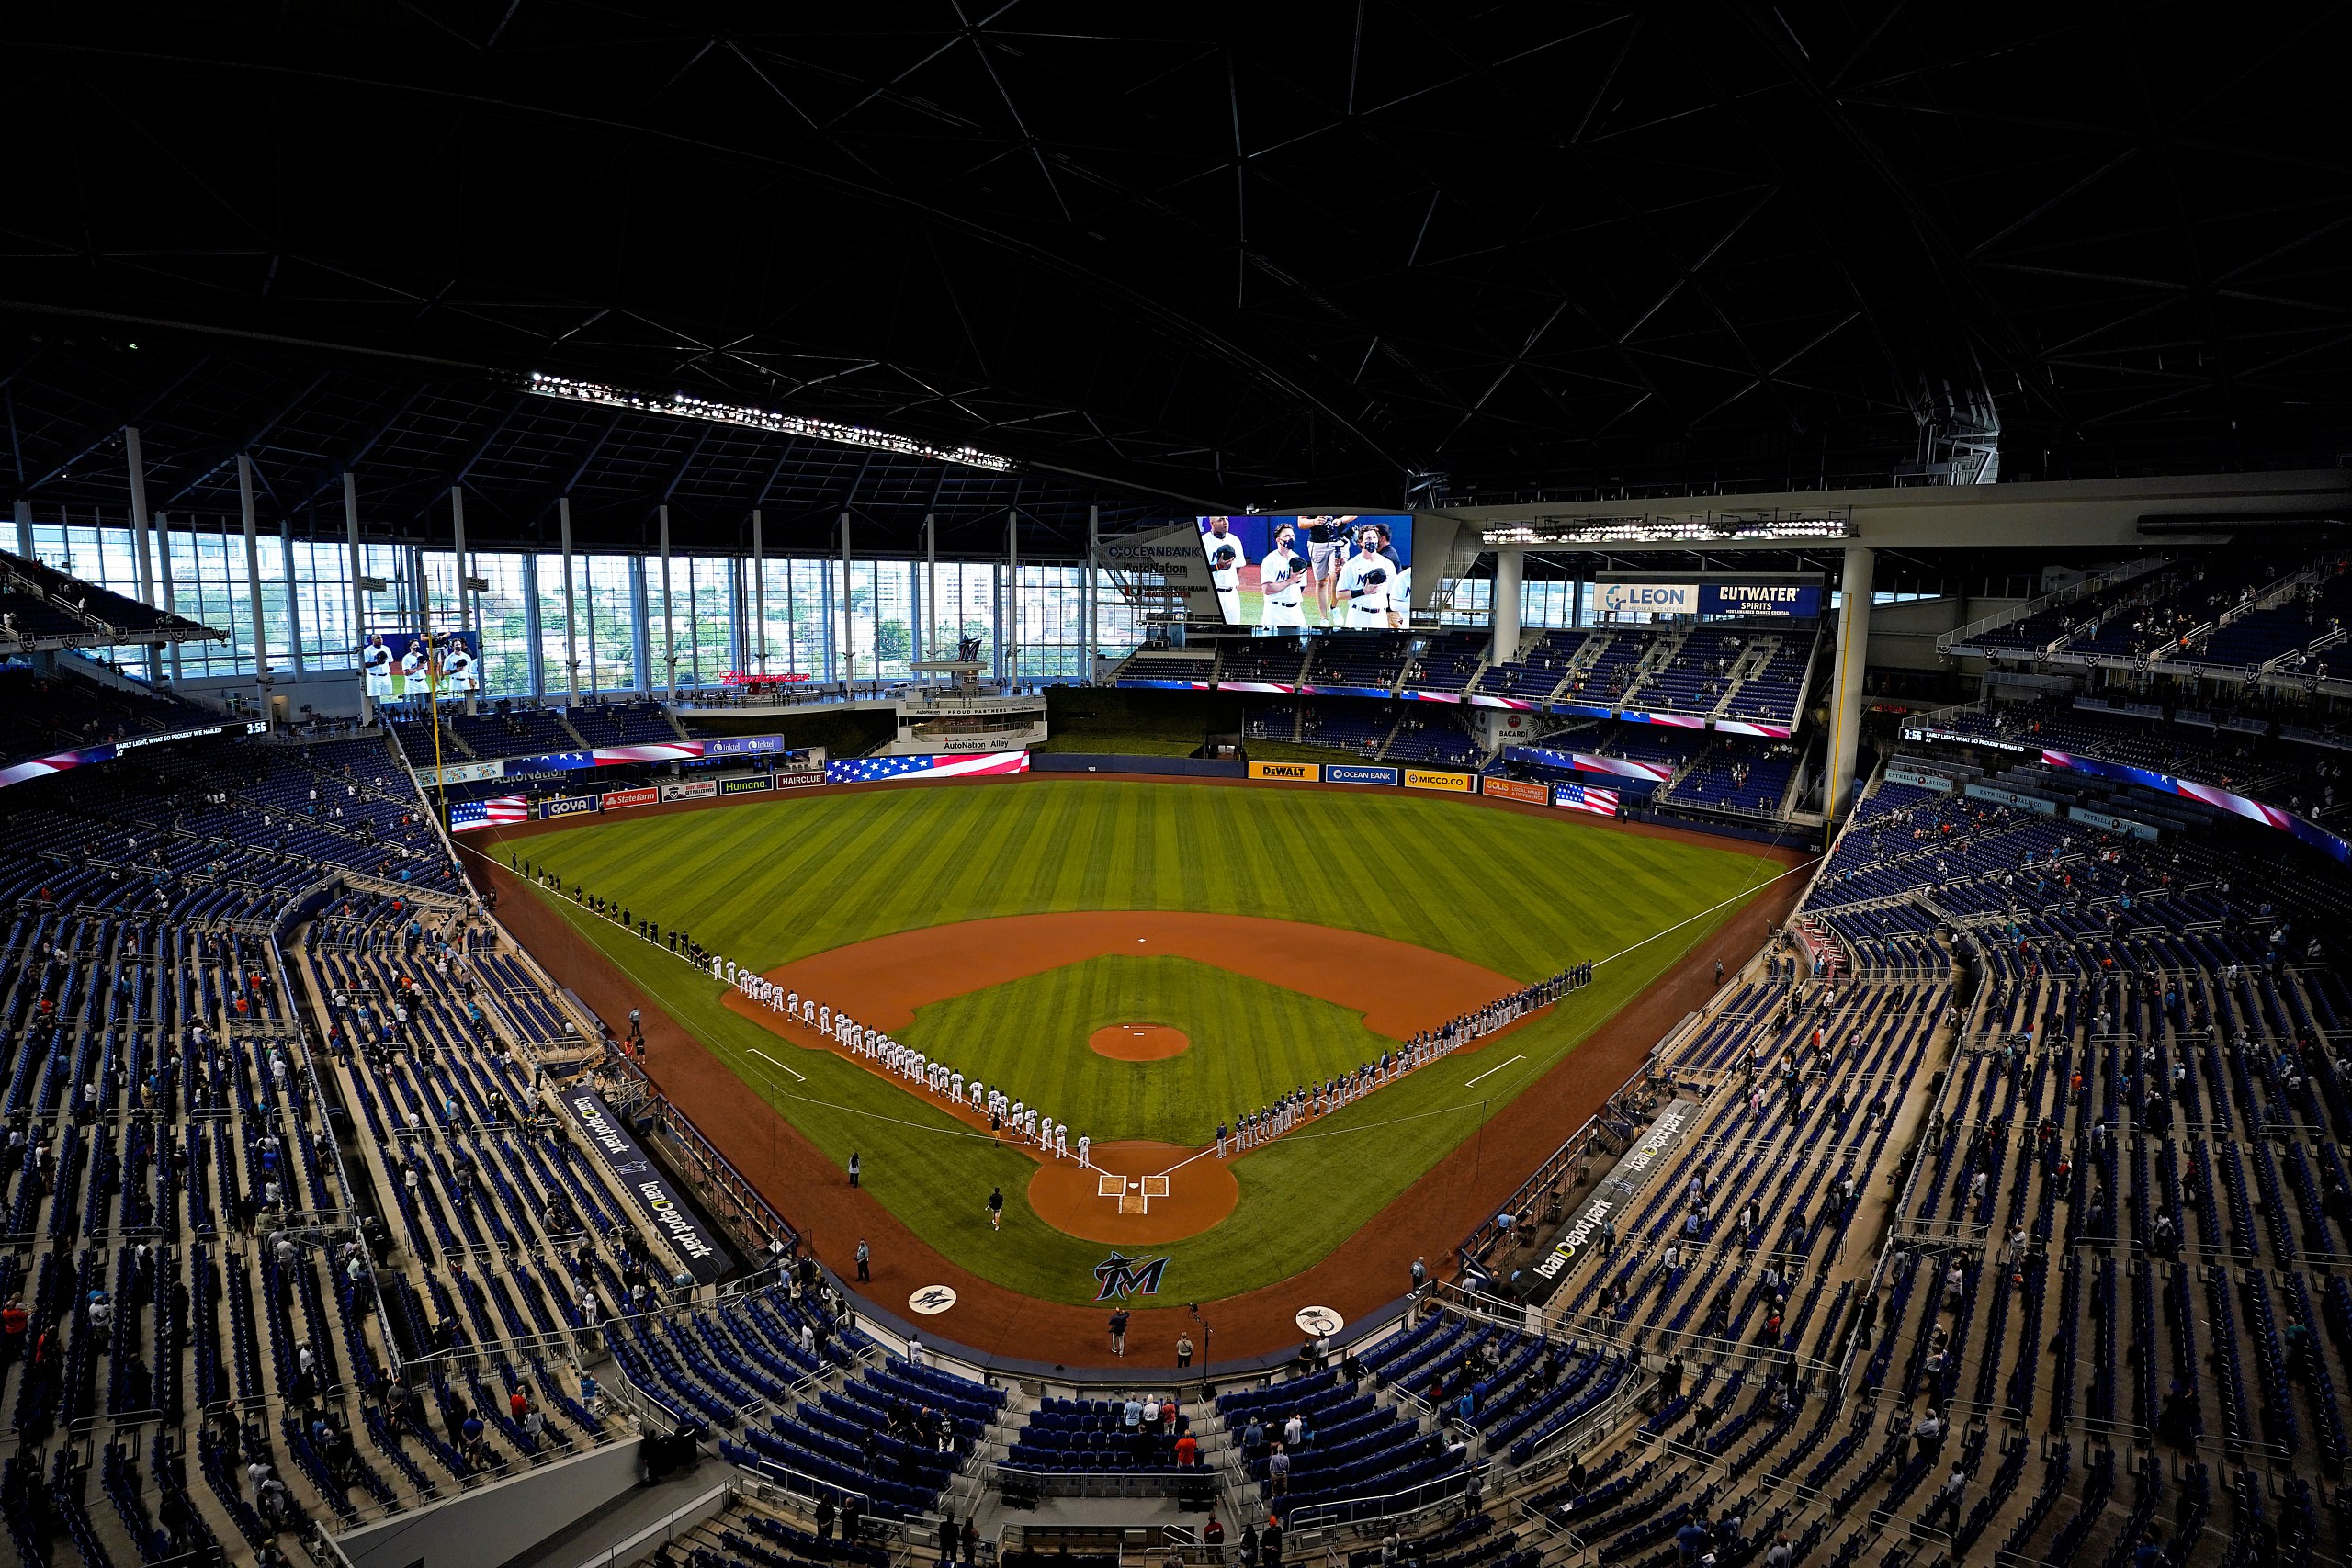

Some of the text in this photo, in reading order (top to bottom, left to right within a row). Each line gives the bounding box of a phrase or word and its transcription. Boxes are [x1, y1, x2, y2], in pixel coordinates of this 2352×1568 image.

[1125, 562, 1187, 574] AutoNation
[1630, 588, 1684, 604] LEON
[1719, 586, 1797, 602] CUTWATER
[1740, 602, 1772, 611] SPIRITS
[719, 671, 810, 685] Budweiser
[247, 722, 266, 735] 3:56
[1904, 728, 1923, 741] 3:56
[116, 741, 132, 750] EARLY
[149, 736, 163, 744] WHAT
[171, 731, 193, 740] PROUDLY
[723, 742, 741, 750] Inktel
[758, 739, 774, 749] Inktel
[944, 739, 1009, 750] AutoNation Alley
[1926, 731, 1941, 739] EARLY
[1979, 739, 1999, 748] PROUDLY
[2007, 744, 2025, 752] HAILED
[782, 774, 822, 785] HAIRCLUB
[1343, 771, 1369, 779] OCEAN
[1419, 776, 1464, 786] MICCO.CO
[1888, 773, 1950, 788] ESTRELLA JALISCO
[1487, 780, 1509, 791] SOLIS
[1979, 790, 2041, 807] ESTRELLA JALISCO
[551, 799, 587, 814] GOYA
[2084, 813, 2144, 834] ESTRELLA JALISCO
[572, 1096, 629, 1155] loanDepot park
[1624, 1112, 1685, 1172] loanDepot park
[638, 1180, 713, 1259] loanDepot park
[1533, 1198, 1613, 1280] loanDepot park
